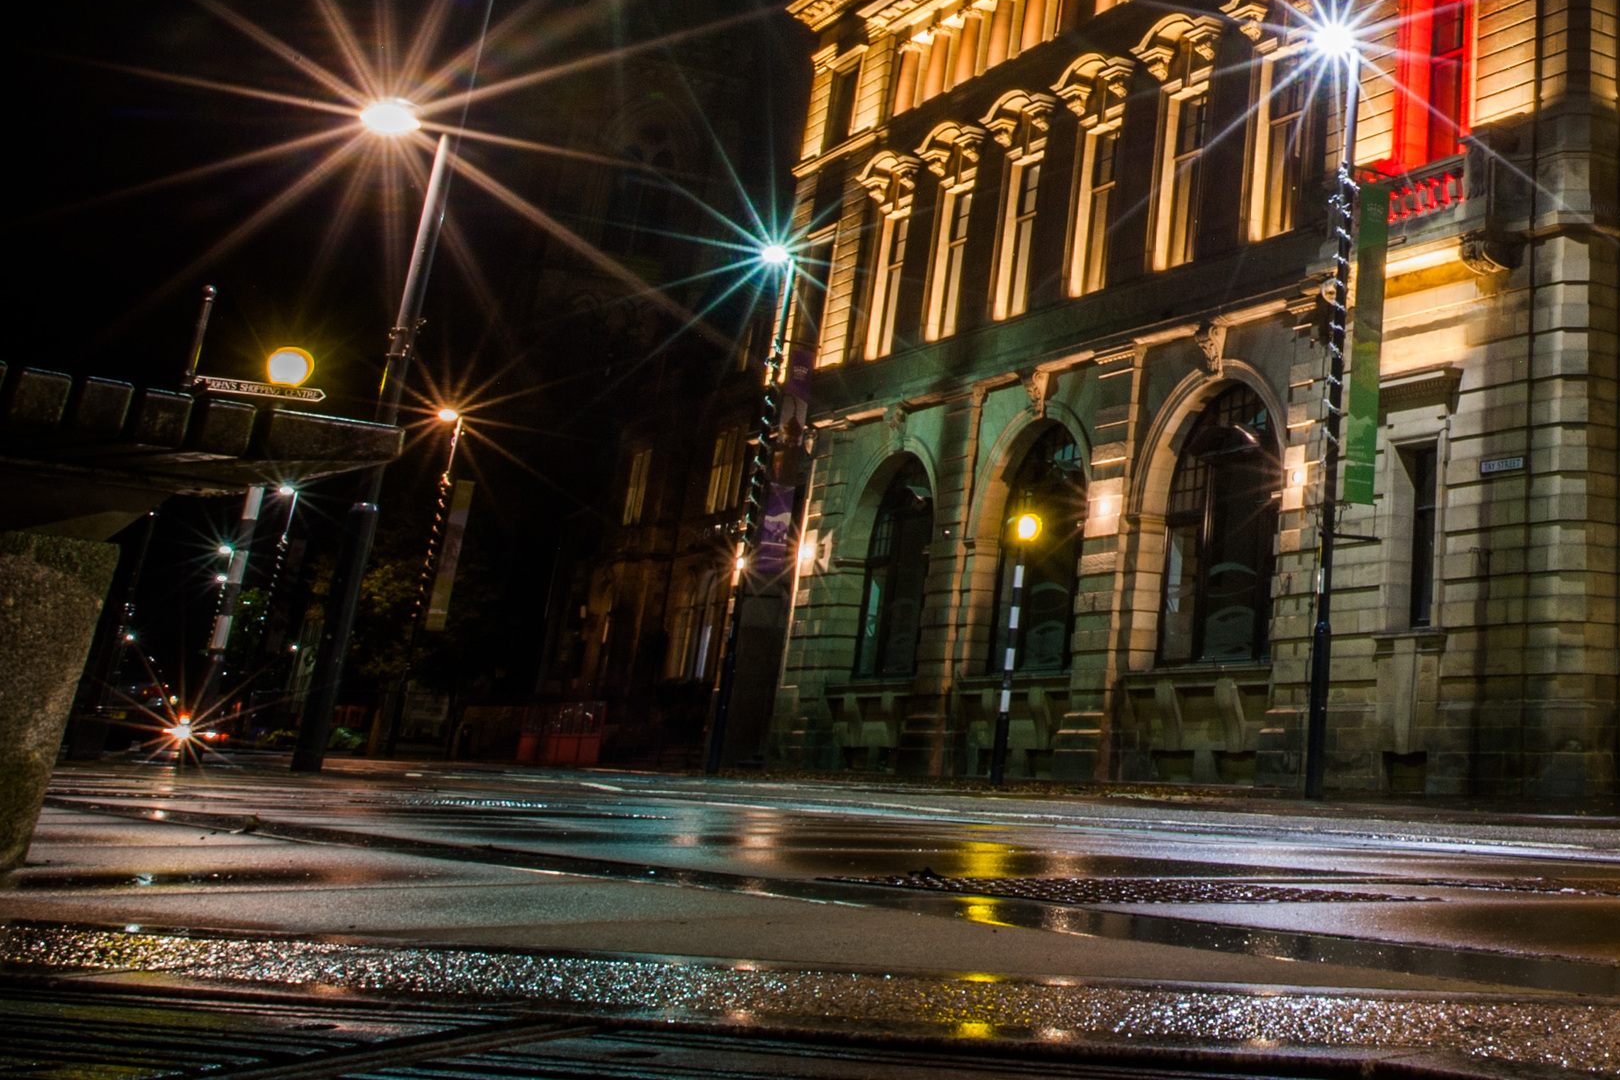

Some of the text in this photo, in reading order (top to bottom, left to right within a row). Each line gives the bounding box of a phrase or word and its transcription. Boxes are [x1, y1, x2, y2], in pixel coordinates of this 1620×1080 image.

[239, 383, 280, 395] SHOPPING
[284, 388, 319, 399] CENTRE
[1484, 458, 1521, 471] TAY STREET
